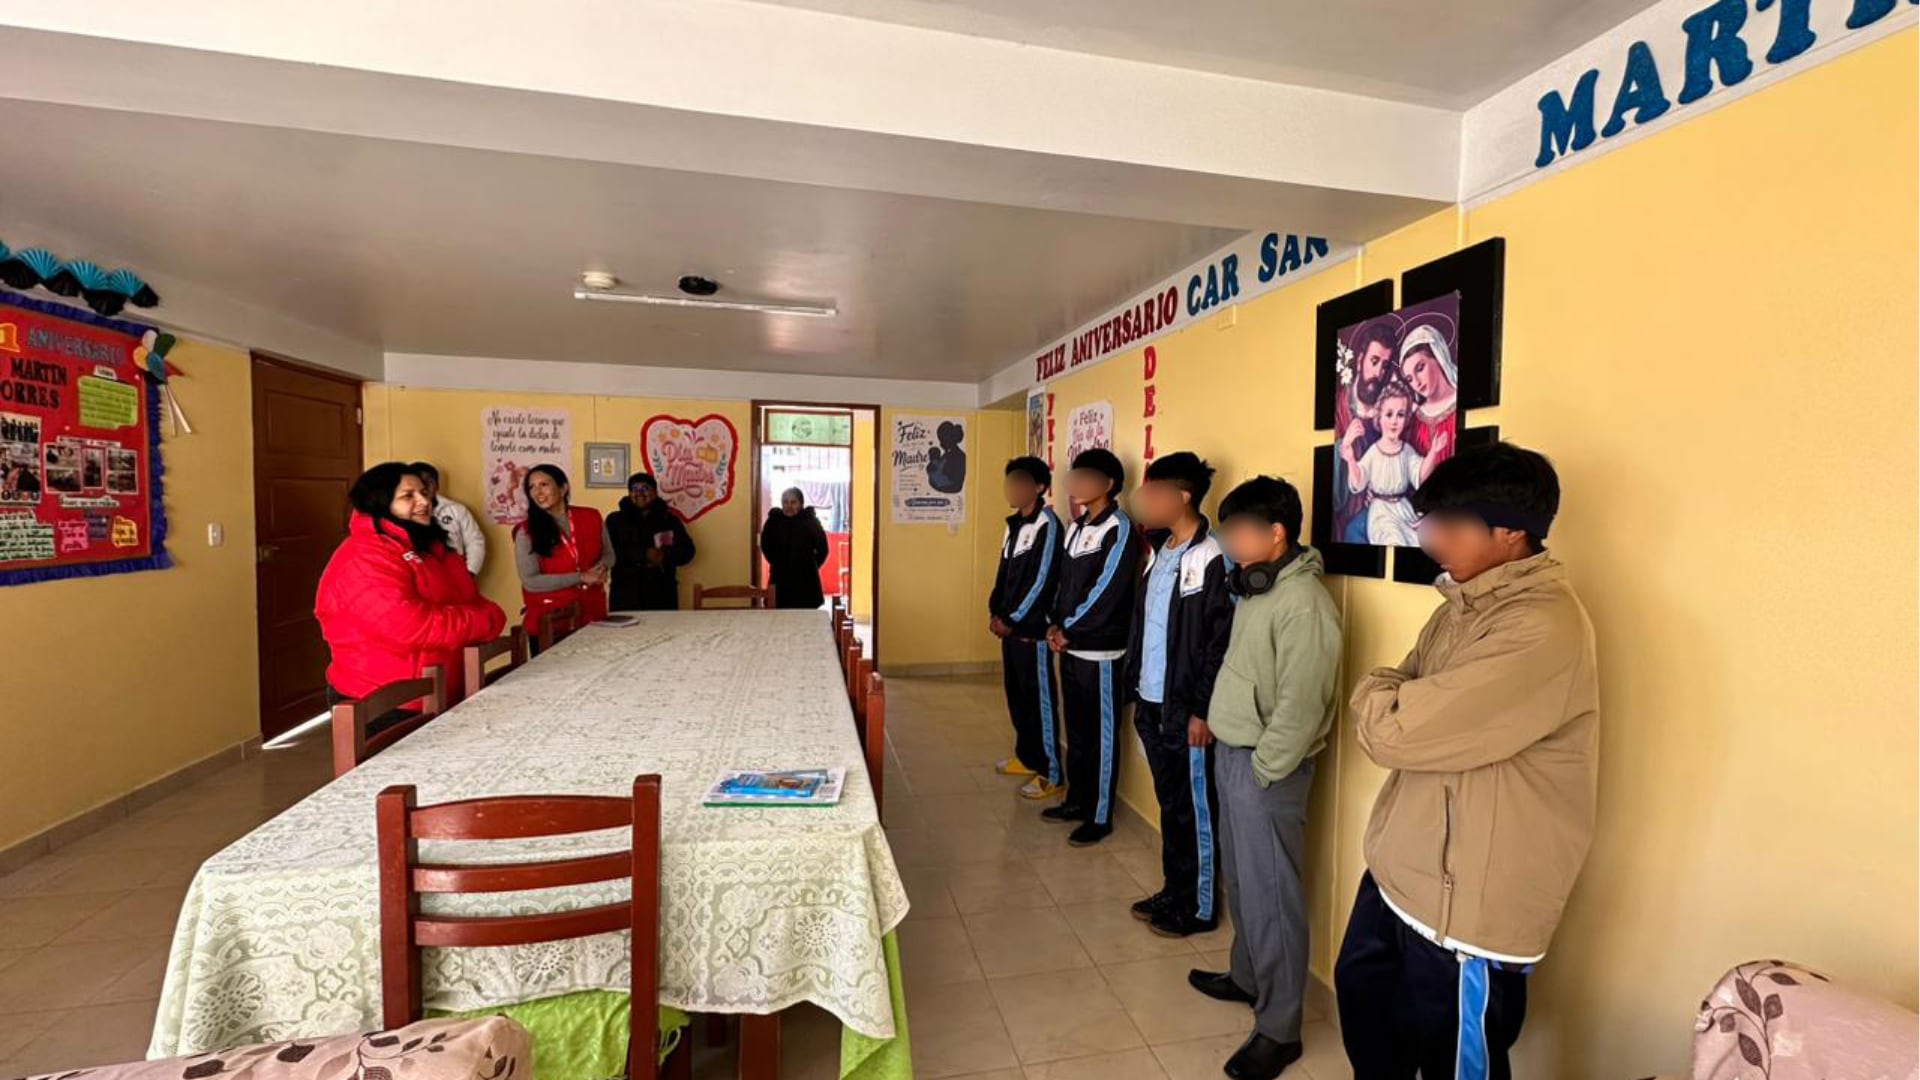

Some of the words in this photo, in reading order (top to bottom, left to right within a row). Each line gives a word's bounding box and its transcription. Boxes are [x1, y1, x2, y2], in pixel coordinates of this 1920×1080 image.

[1036, 343, 1066, 382] FELIZ
[1070, 286, 1178, 367] ANIVERSARIO
[1186, 253, 1240, 316] CAR
[1535, 0, 1920, 168] MART
[28, 324, 126, 367] ANIVERSARIO
[11, 357, 68, 385] MARTIN
[1079, 409, 1099, 426] Feliz
[898, 422, 926, 443] Feliz
[892, 450, 928, 467] Madre
